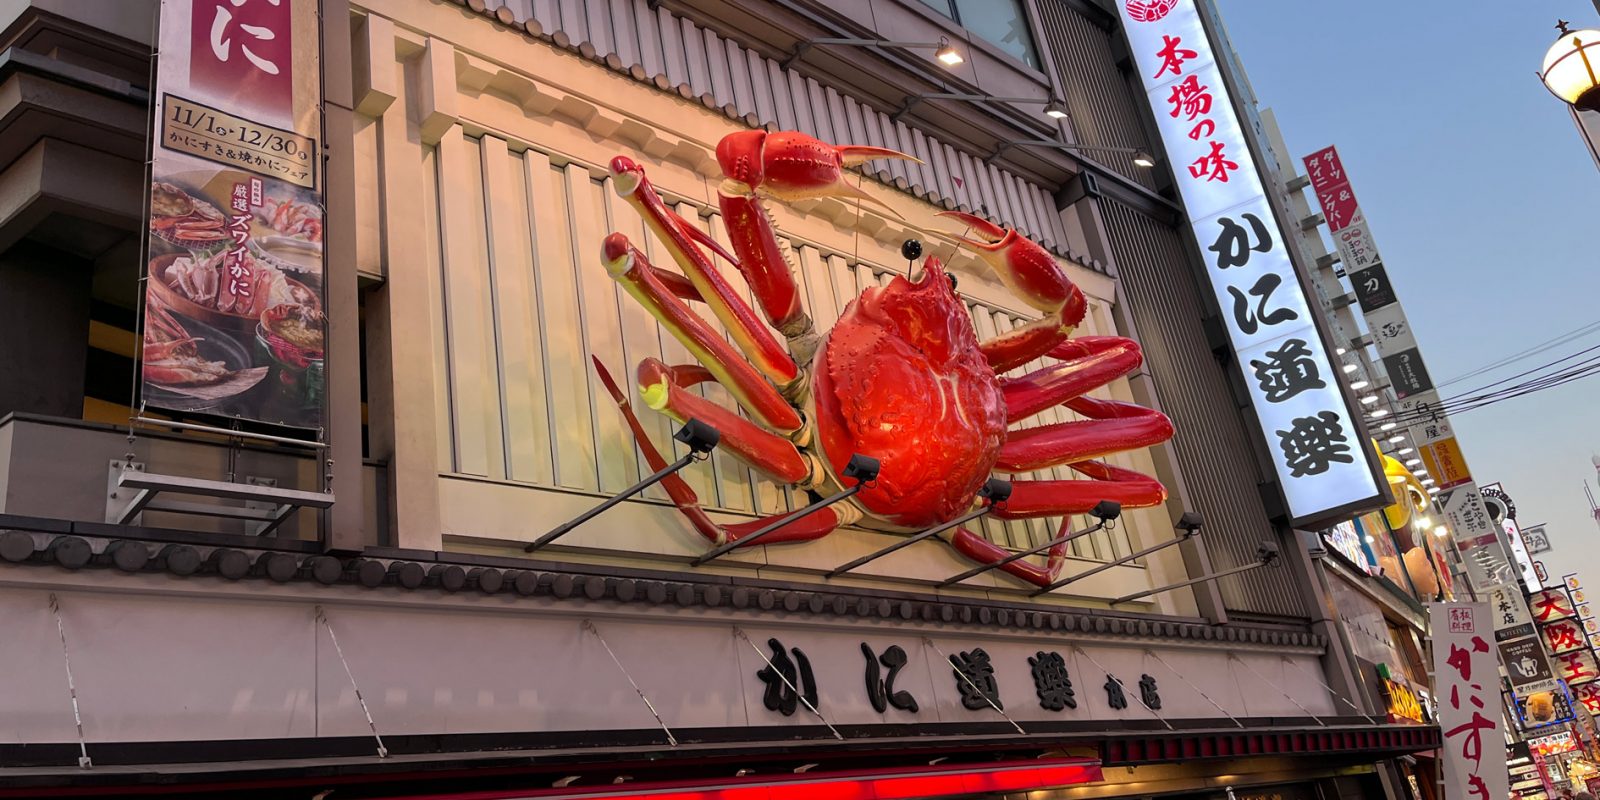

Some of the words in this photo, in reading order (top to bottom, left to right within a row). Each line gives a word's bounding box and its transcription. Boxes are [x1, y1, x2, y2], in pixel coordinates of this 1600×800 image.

[210, 0, 280, 75] に
[237, 126, 298, 155] 12/30
[1153, 35, 1239, 182] 本場の味
[230, 183, 252, 296] 厳選ズワイかに
[1363, 277, 1380, 292] 刀
